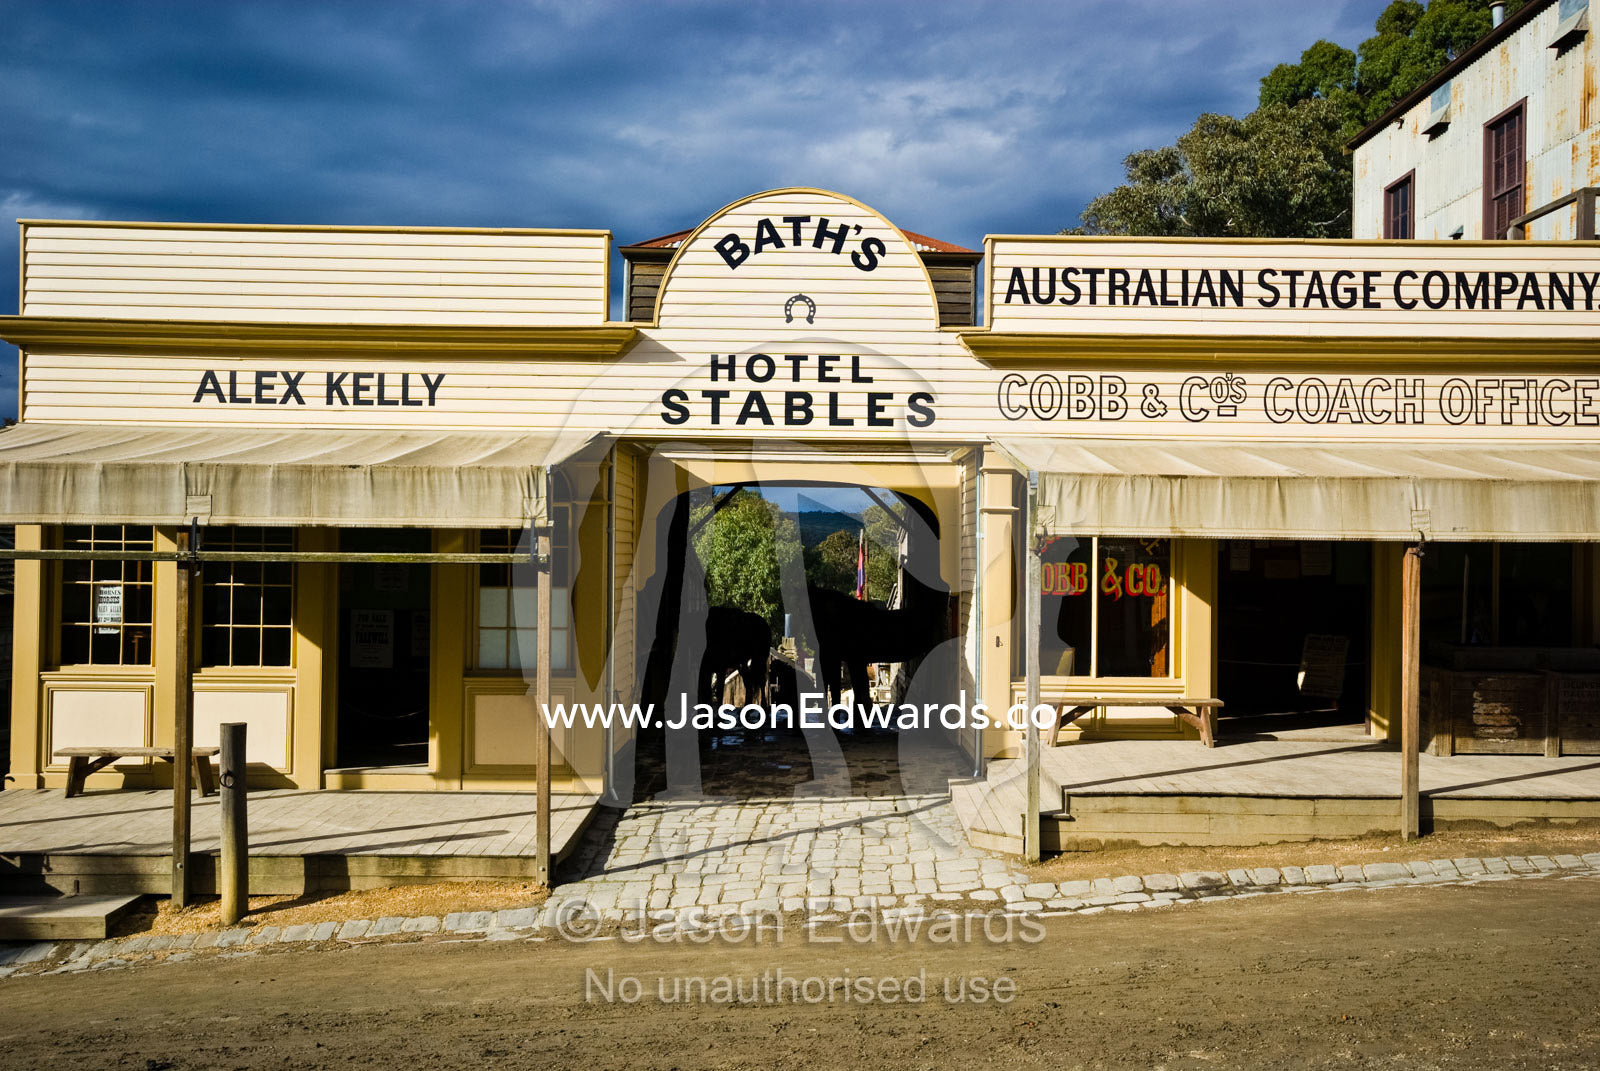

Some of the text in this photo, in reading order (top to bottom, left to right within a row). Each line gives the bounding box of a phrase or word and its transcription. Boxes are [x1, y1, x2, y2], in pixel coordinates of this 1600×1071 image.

[714, 215, 887, 272] BATH'S
[1004, 267, 1244, 307] AUSTRALIAN
[1257, 269, 1382, 309] STAGE
[192, 370, 446, 407] ALEX KELLY
[710, 353, 874, 384] HOTEL
[660, 388, 936, 427] STABLES
[998, 373, 1129, 421] COBB
[1140, 383, 1168, 418] &
[1264, 376, 1425, 424] COACH
[1439, 377, 1600, 426] OFFICE
[1041, 562, 1089, 595] OBB
[1101, 557, 1123, 602] &
